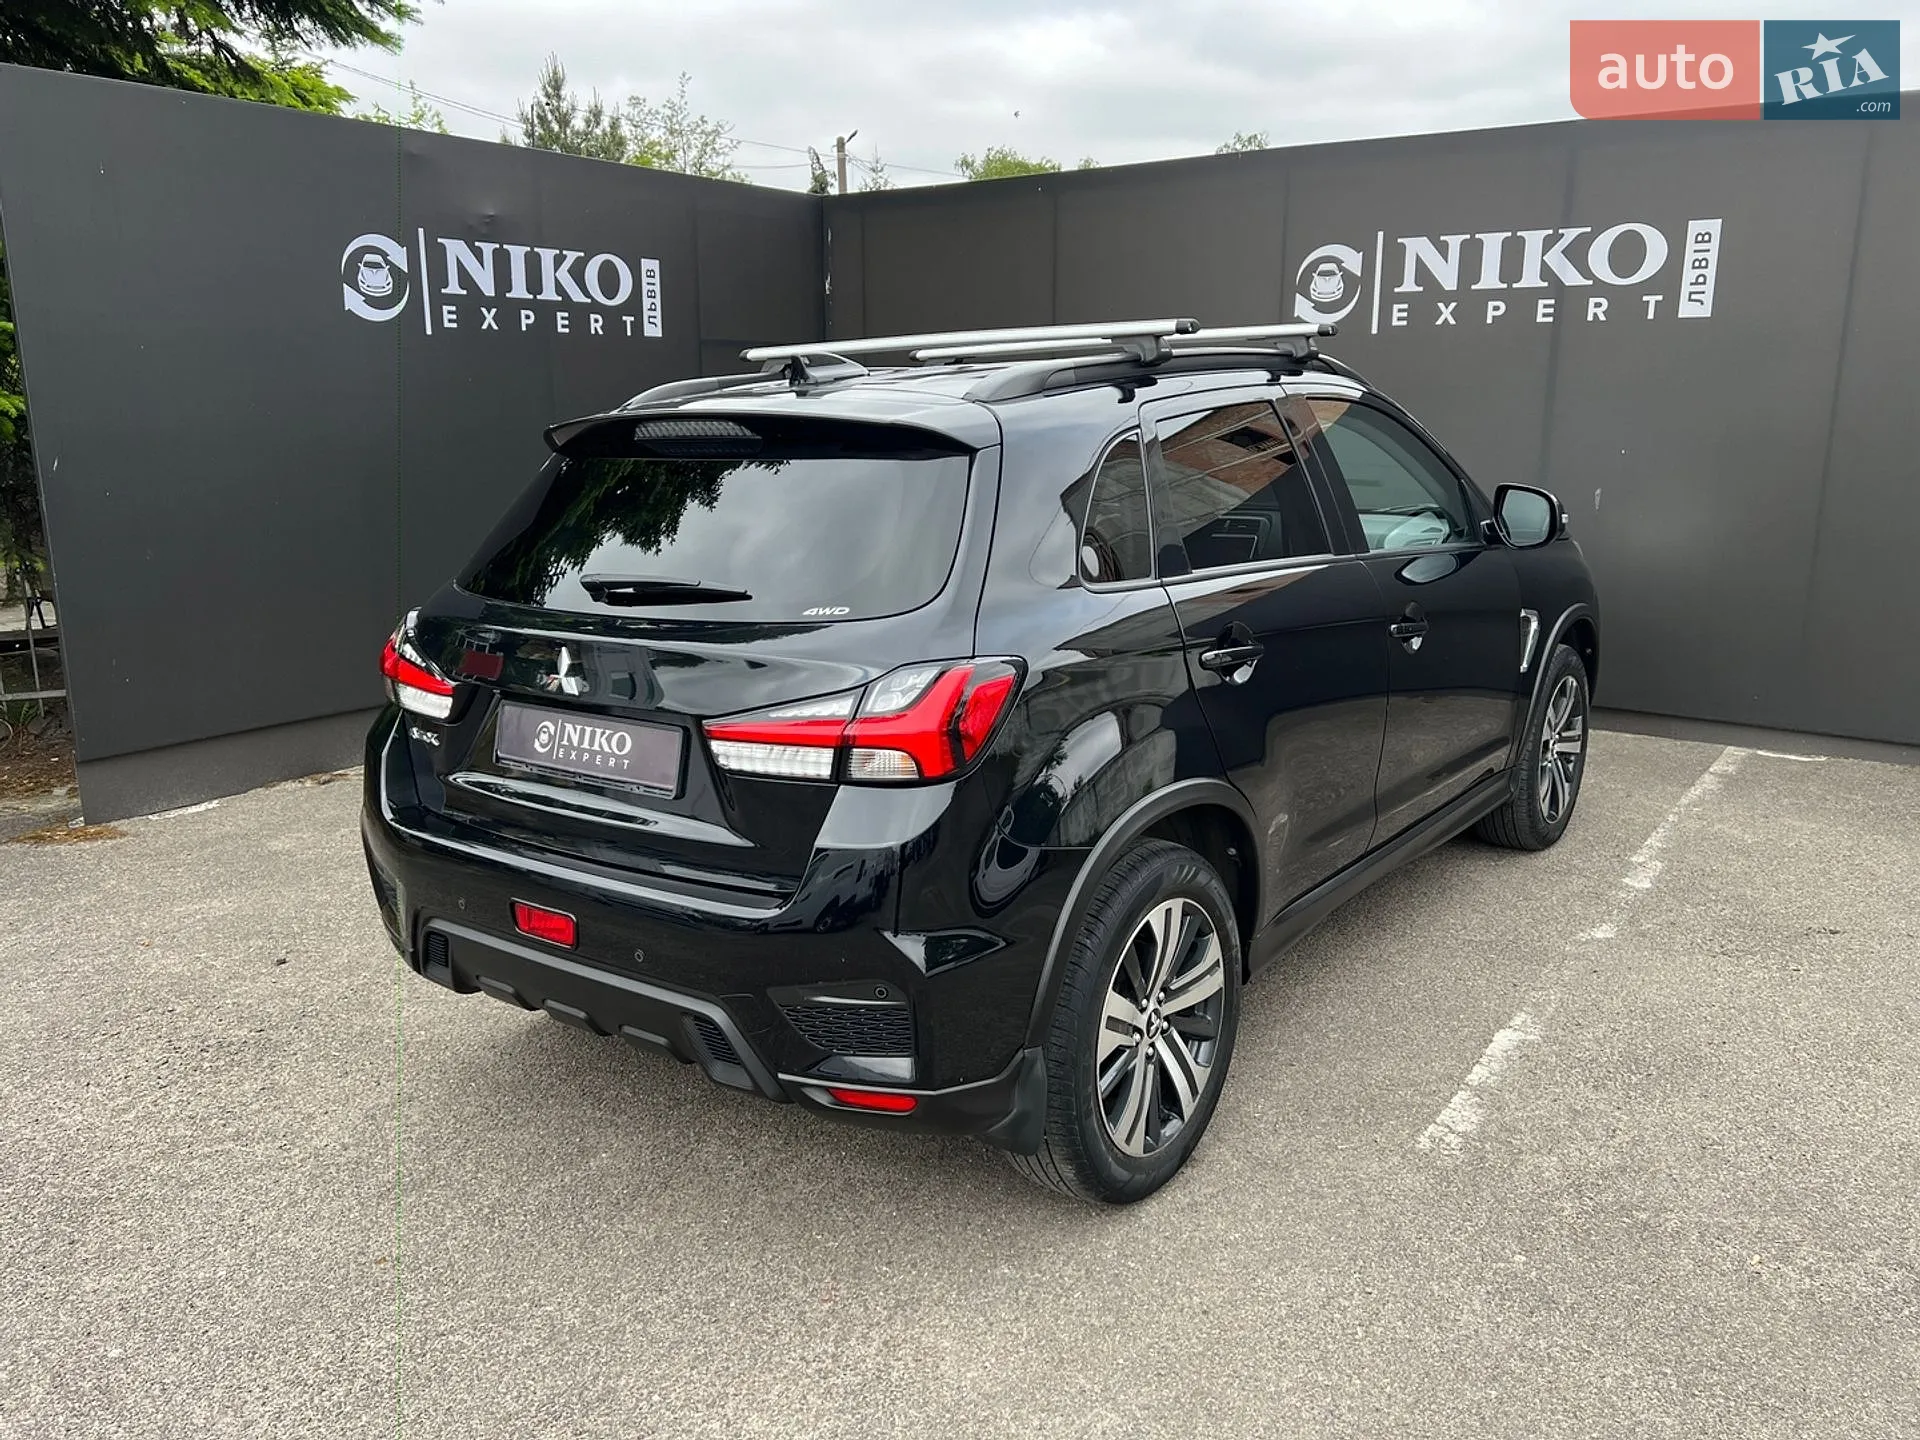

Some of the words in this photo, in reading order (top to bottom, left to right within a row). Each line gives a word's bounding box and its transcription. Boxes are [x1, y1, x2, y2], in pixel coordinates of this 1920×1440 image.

[437, 237, 633, 306] NIKO
[1393, 222, 1669, 293] NIKO
[1688, 231, 1712, 306] ЛЬВІВ
[442, 305, 635, 336] EXPERT
[645, 268, 658, 328] ЛЬВІВ
[1391, 294, 1664, 327] EXPERT
[558, 747, 630, 770] EXPERT
[560, 722, 632, 756] NIKO
